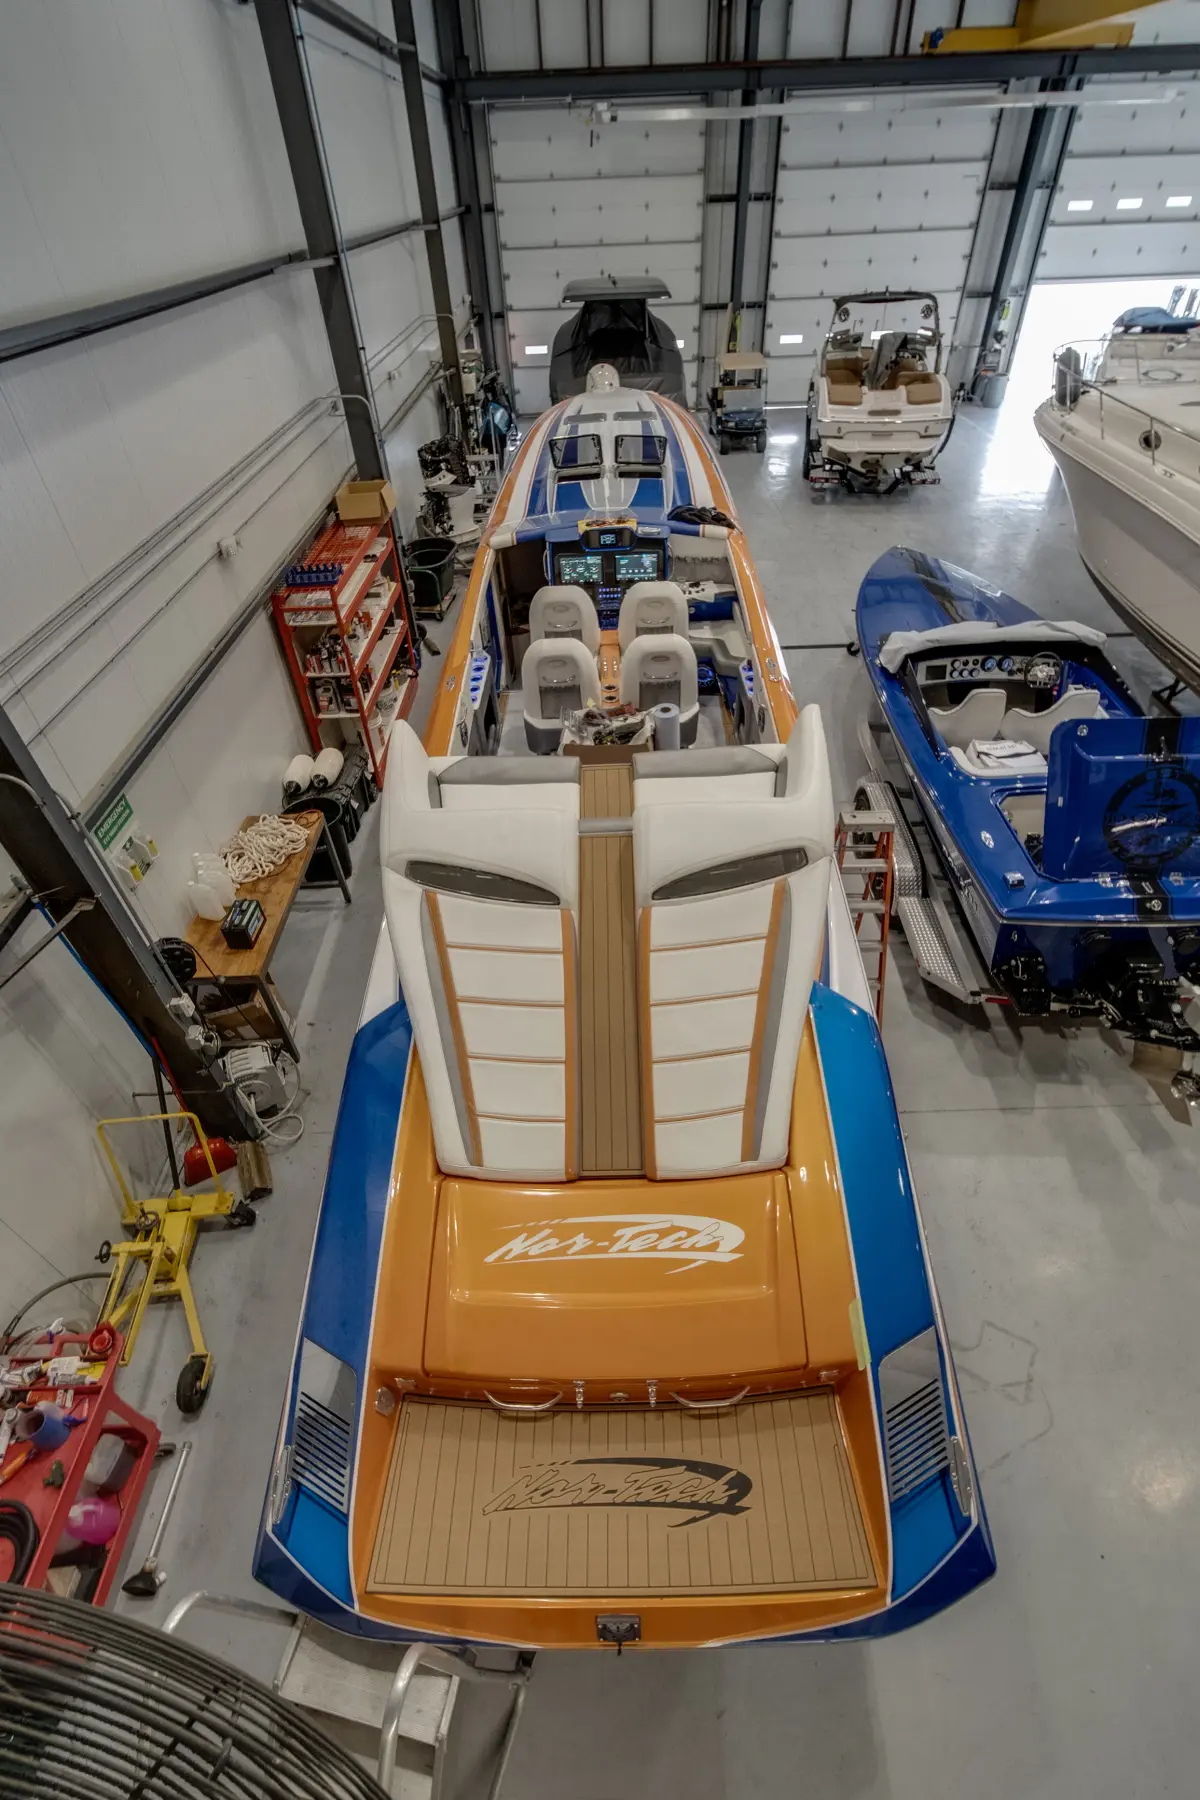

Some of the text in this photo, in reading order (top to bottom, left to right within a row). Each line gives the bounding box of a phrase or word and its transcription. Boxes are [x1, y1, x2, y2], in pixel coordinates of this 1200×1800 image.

[97, 798, 126, 837] EMERGENCY
[483, 1219, 730, 1263] Nor-Tech
[482, 1465, 739, 1516] Nor-Tech
